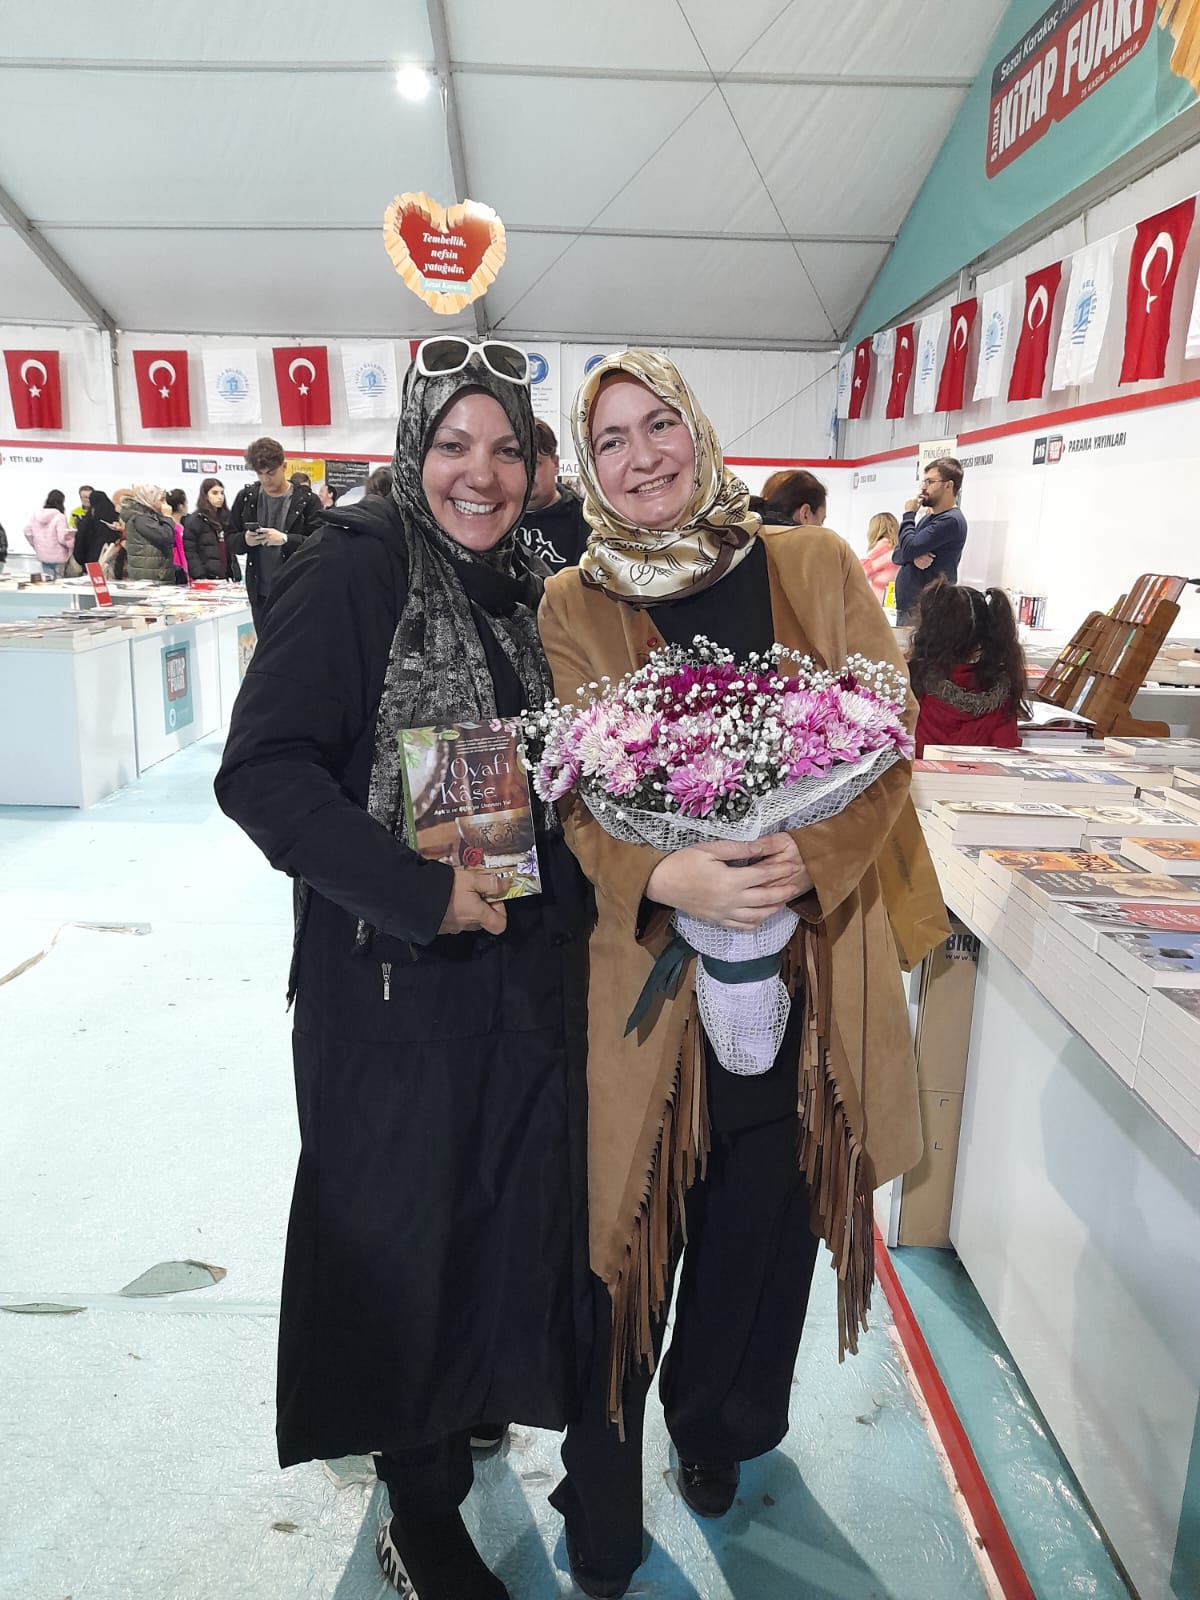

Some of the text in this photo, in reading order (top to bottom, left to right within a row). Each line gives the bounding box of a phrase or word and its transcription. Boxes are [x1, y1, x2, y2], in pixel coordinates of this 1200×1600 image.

[1001, 45, 1023, 82] Sezai
[1023, 10, 1059, 59] Karakoç
[422, 232, 467, 248] Tembellik,
[430, 249, 458, 260] nefsin
[423, 263, 465, 275] yatağıdır.
[1093, 431, 1127, 450] YAYINLARI
